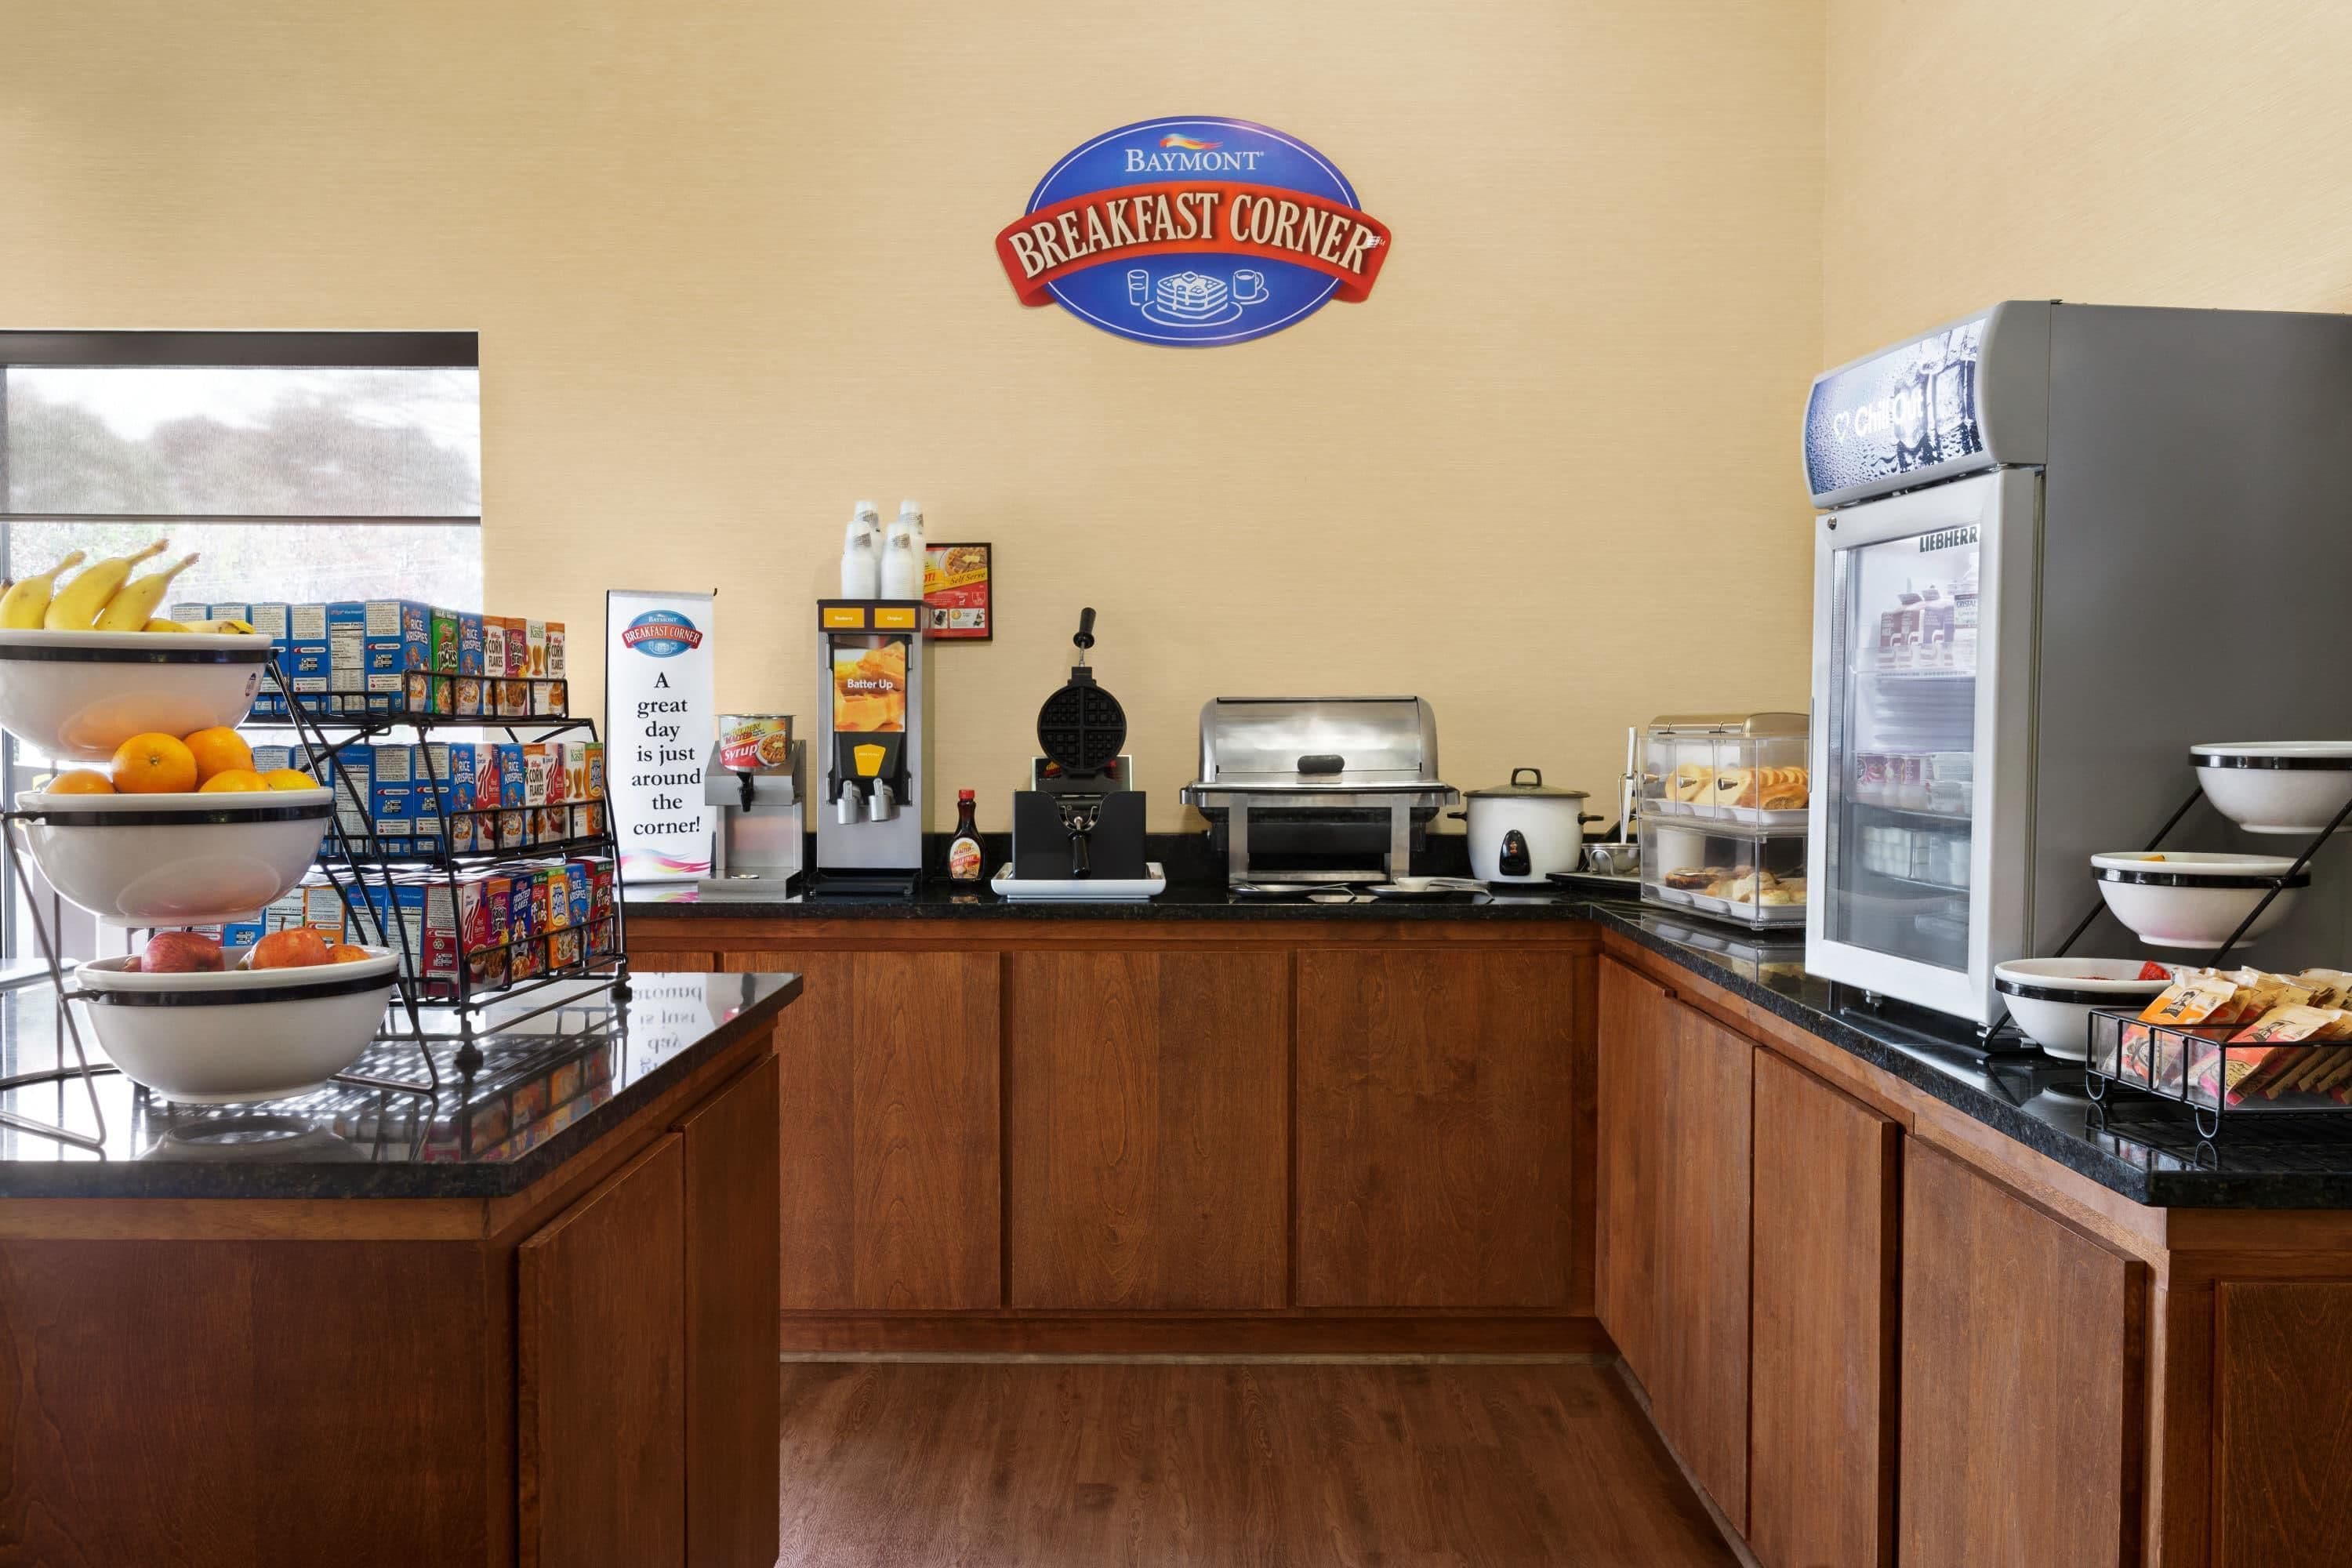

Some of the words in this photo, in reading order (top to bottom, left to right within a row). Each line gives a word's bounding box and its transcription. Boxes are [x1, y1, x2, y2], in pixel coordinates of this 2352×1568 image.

[1125, 148, 1261, 172] BAYMONT
[1008, 191, 1219, 279] BREAKFAST
[1229, 194, 1374, 275] CORNER
[1854, 398, 1889, 436] Chill
[1893, 389, 1924, 426] Out
[1919, 526, 1978, 553] LIEBHERR
[949, 575, 966, 585] Self
[966, 572, 986, 581] Serve
[410, 619, 423, 631] RICE
[406, 630, 428, 644] KRISPIES
[466, 627, 478, 640] RICE
[625, 626, 669, 644] BREAKFAST
[670, 626, 700, 644] CORNER
[462, 639, 481, 652] KRISPIES
[488, 639, 502, 654] CORN
[551, 644, 564, 657] CORN
[437, 650, 458, 670] JACKS
[488, 654, 503, 668] FLAKES
[551, 659, 564, 670] FLAKES
[653, 672, 670, 688] A
[847, 678, 877, 689] Batter
[879, 679, 894, 691] Up
[637, 699, 688, 719] great
[644, 720, 681, 742] day
[637, 745, 653, 762] is
[659, 745, 695, 768] just
[724, 744, 758, 761] Syrup
[459, 760, 470, 772] RICE
[508, 761, 519, 772] RICE
[454, 772, 474, 786] KRISPIES
[504, 773, 523, 785] KRISPIES
[528, 768, 543, 783] CORN
[631, 768, 701, 786] around
[529, 784, 544, 797] FLAKES
[652, 793, 684, 810] the
[633, 816, 701, 836] corner!
[572, 880, 582, 891] RICE
[514, 888, 532, 905] FROSTED
[569, 890, 586, 903] KRISPIES
[514, 898, 529, 913] FLAKES
